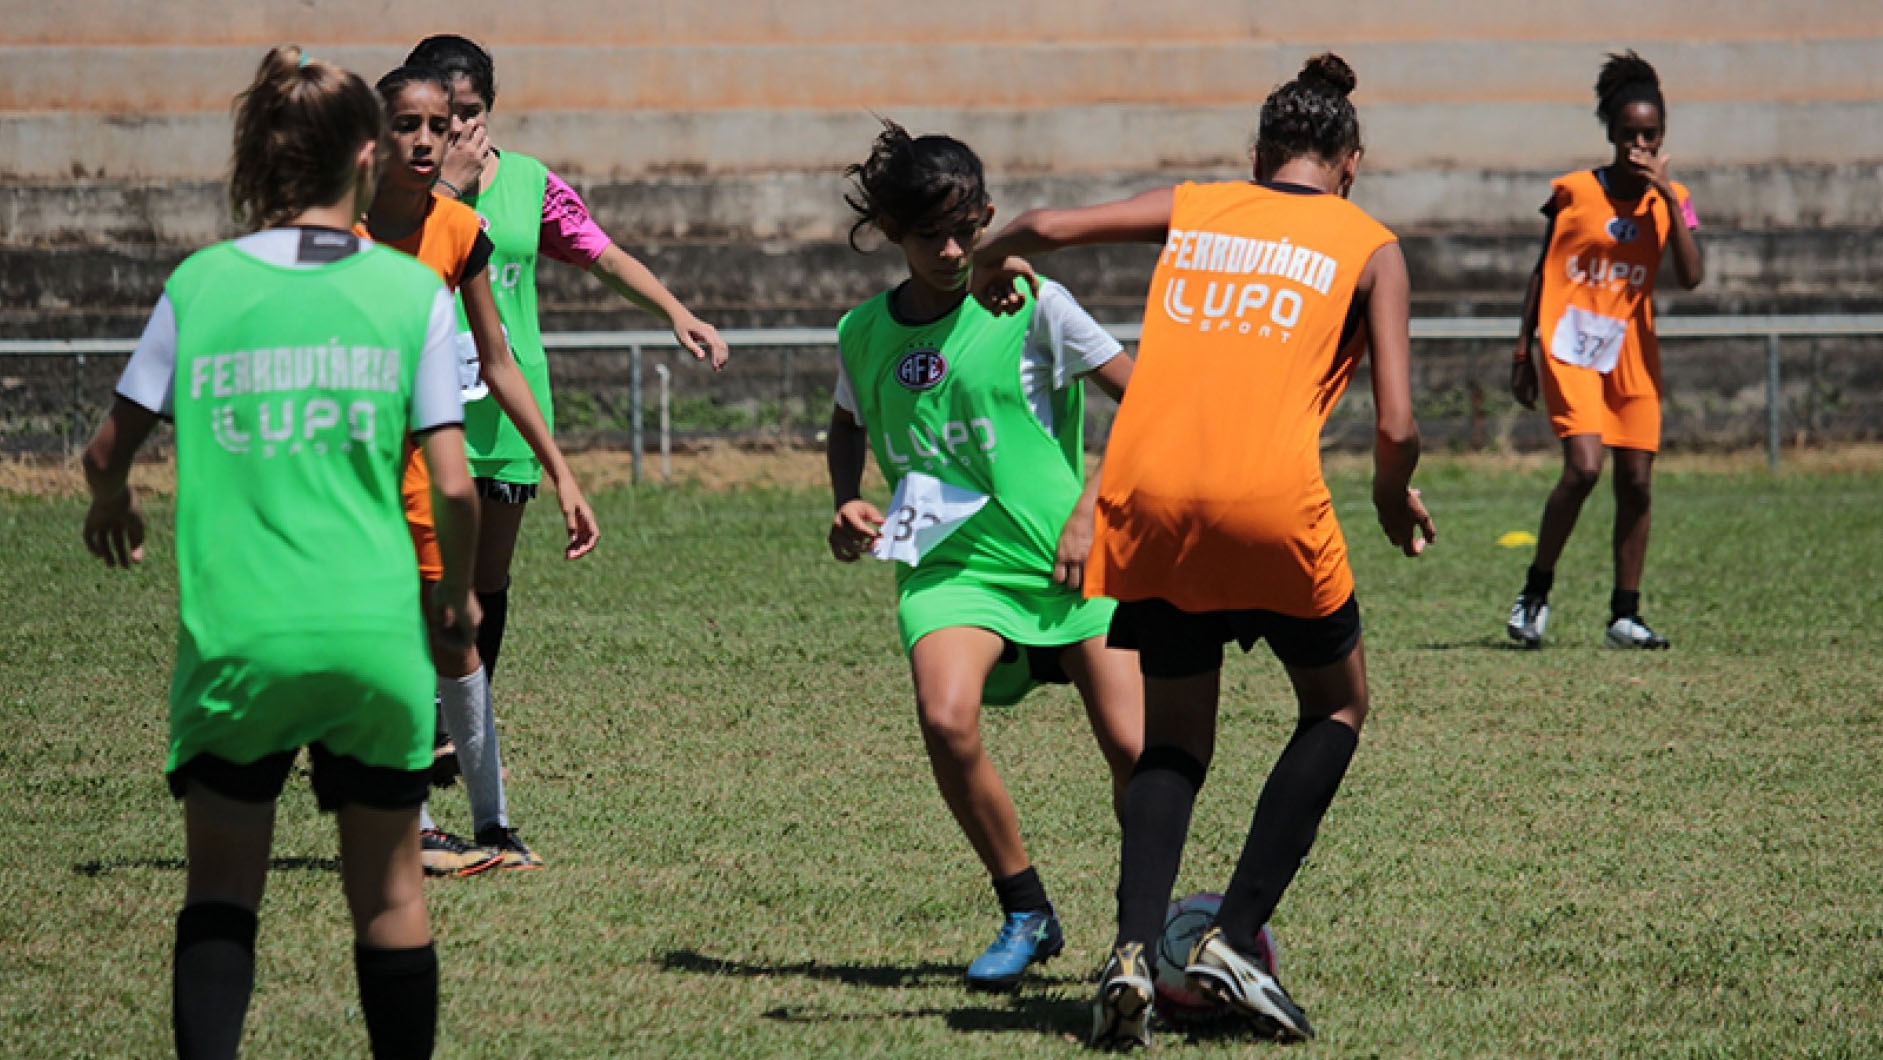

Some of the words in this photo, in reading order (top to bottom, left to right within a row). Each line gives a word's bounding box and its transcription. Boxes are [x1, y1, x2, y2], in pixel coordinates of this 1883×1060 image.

[1163, 230, 1336, 295] FERROVIÁRIA
[1566, 255, 1647, 286] LUPO
[1163, 277, 1303, 328] LUPO
[1200, 319, 1292, 343] SPORT
[1573, 330, 1605, 358] 37
[190, 338, 399, 399] FERROVIÁRIA
[902, 354, 943, 383] AFE
[212, 400, 375, 453] LUPO
[884, 417, 996, 471] LUPO
